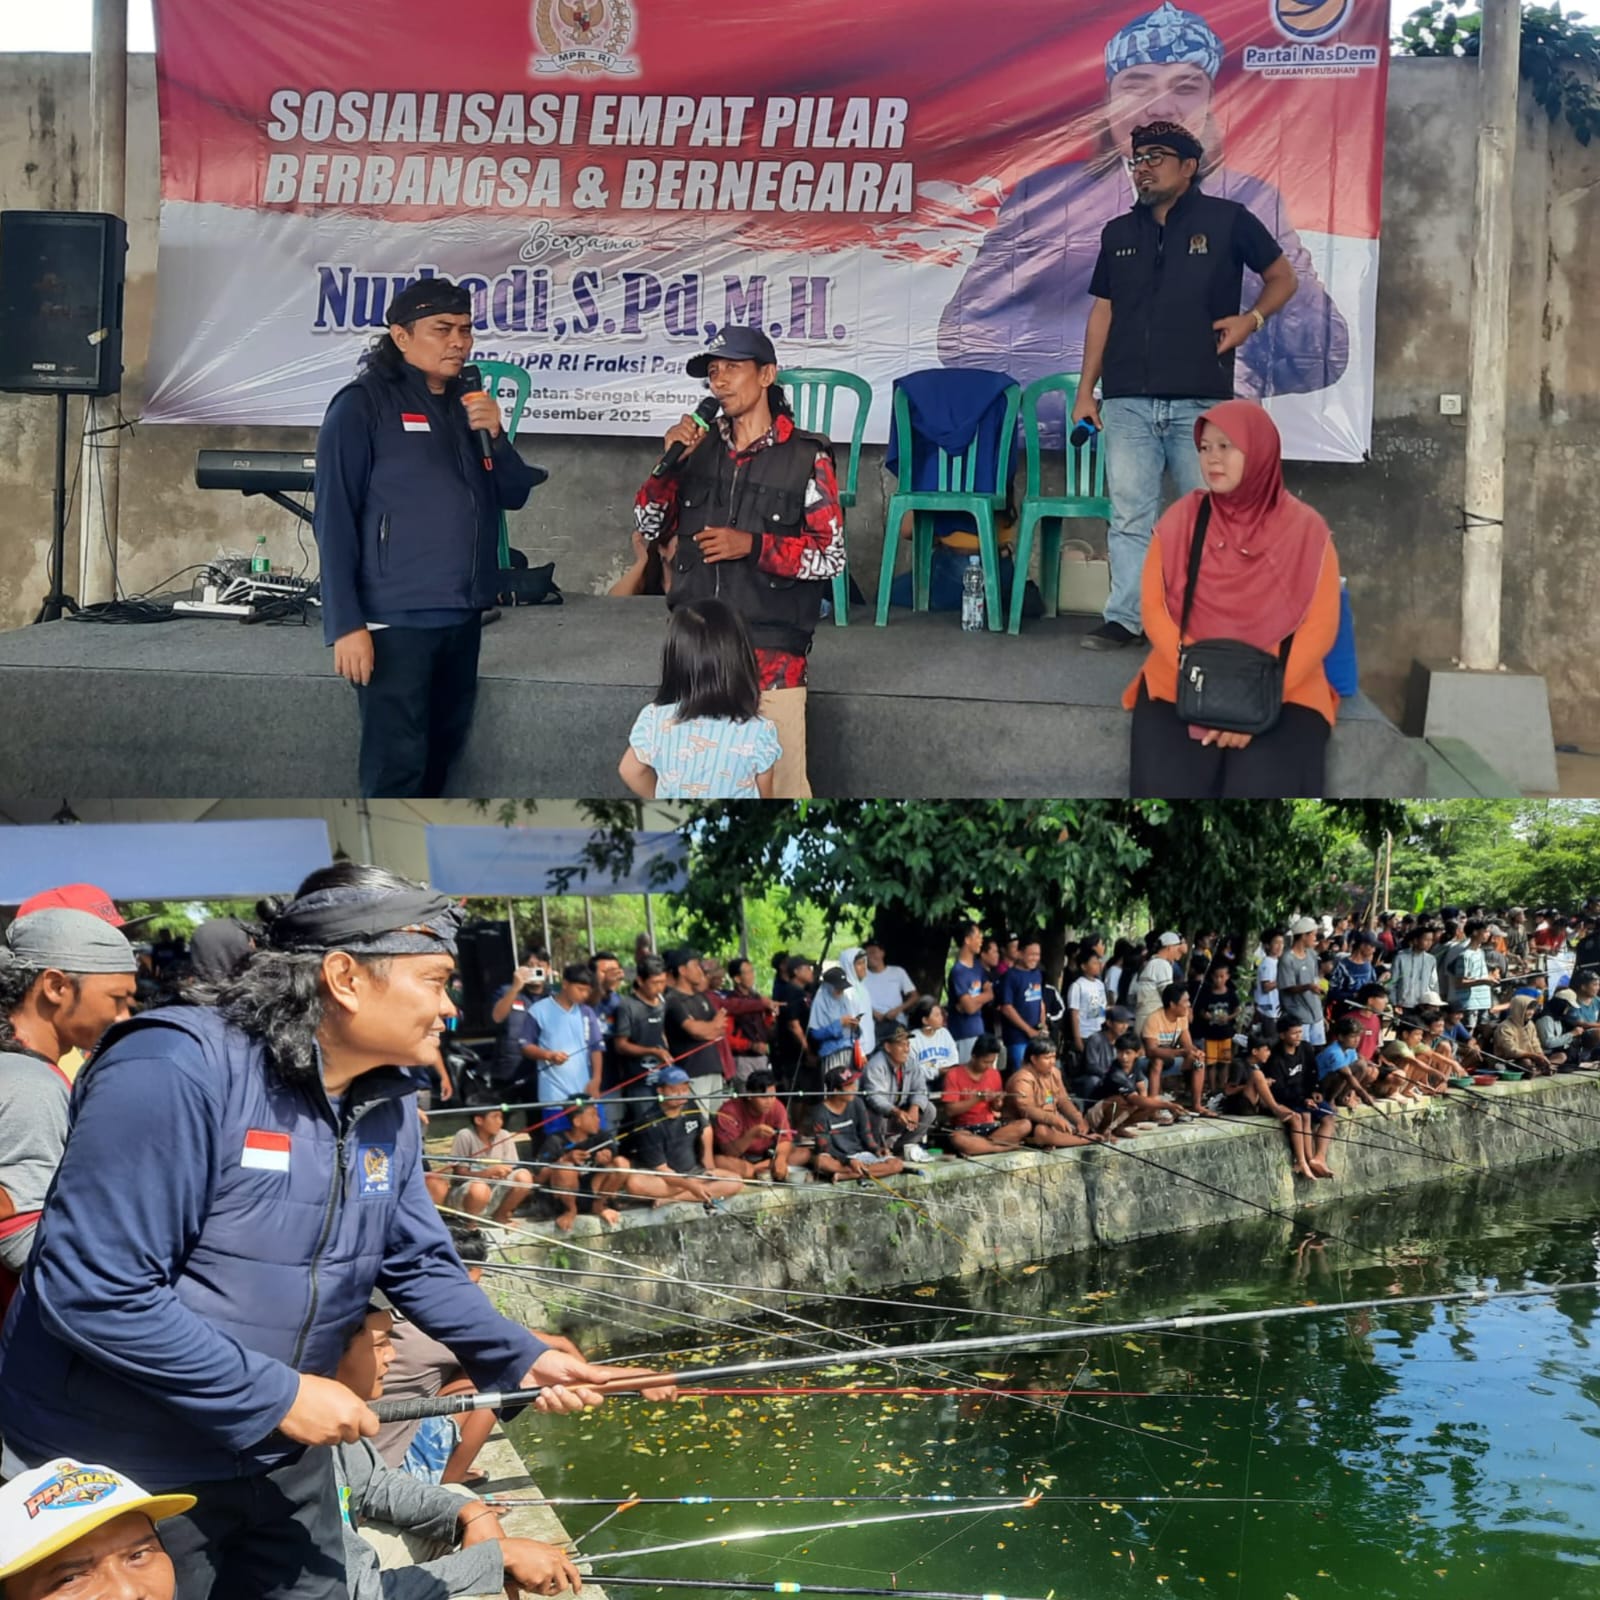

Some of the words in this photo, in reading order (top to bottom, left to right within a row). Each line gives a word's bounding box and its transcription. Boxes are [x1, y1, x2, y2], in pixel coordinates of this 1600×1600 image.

[558, 51, 586, 62] MPR
[598, 53, 611, 64] RI
[1246, 47, 1298, 63] Partai
[1302, 45, 1376, 61] NasDem
[266, 89, 577, 146] SOSIALISASI
[588, 95, 755, 148] EMPAT
[760, 97, 909, 149] PILAR
[263, 153, 562, 207] BERBANGSA
[572, 165, 609, 211] &
[618, 159, 913, 213] BERNEGARA
[557, 354, 576, 372] RI
[583, 354, 646, 373] Fraksi
[650, 355, 687, 374] Par
[573, 388, 641, 406] Srengat
[520, 406, 603, 421] Desember
[608, 408, 651, 423] 2025
